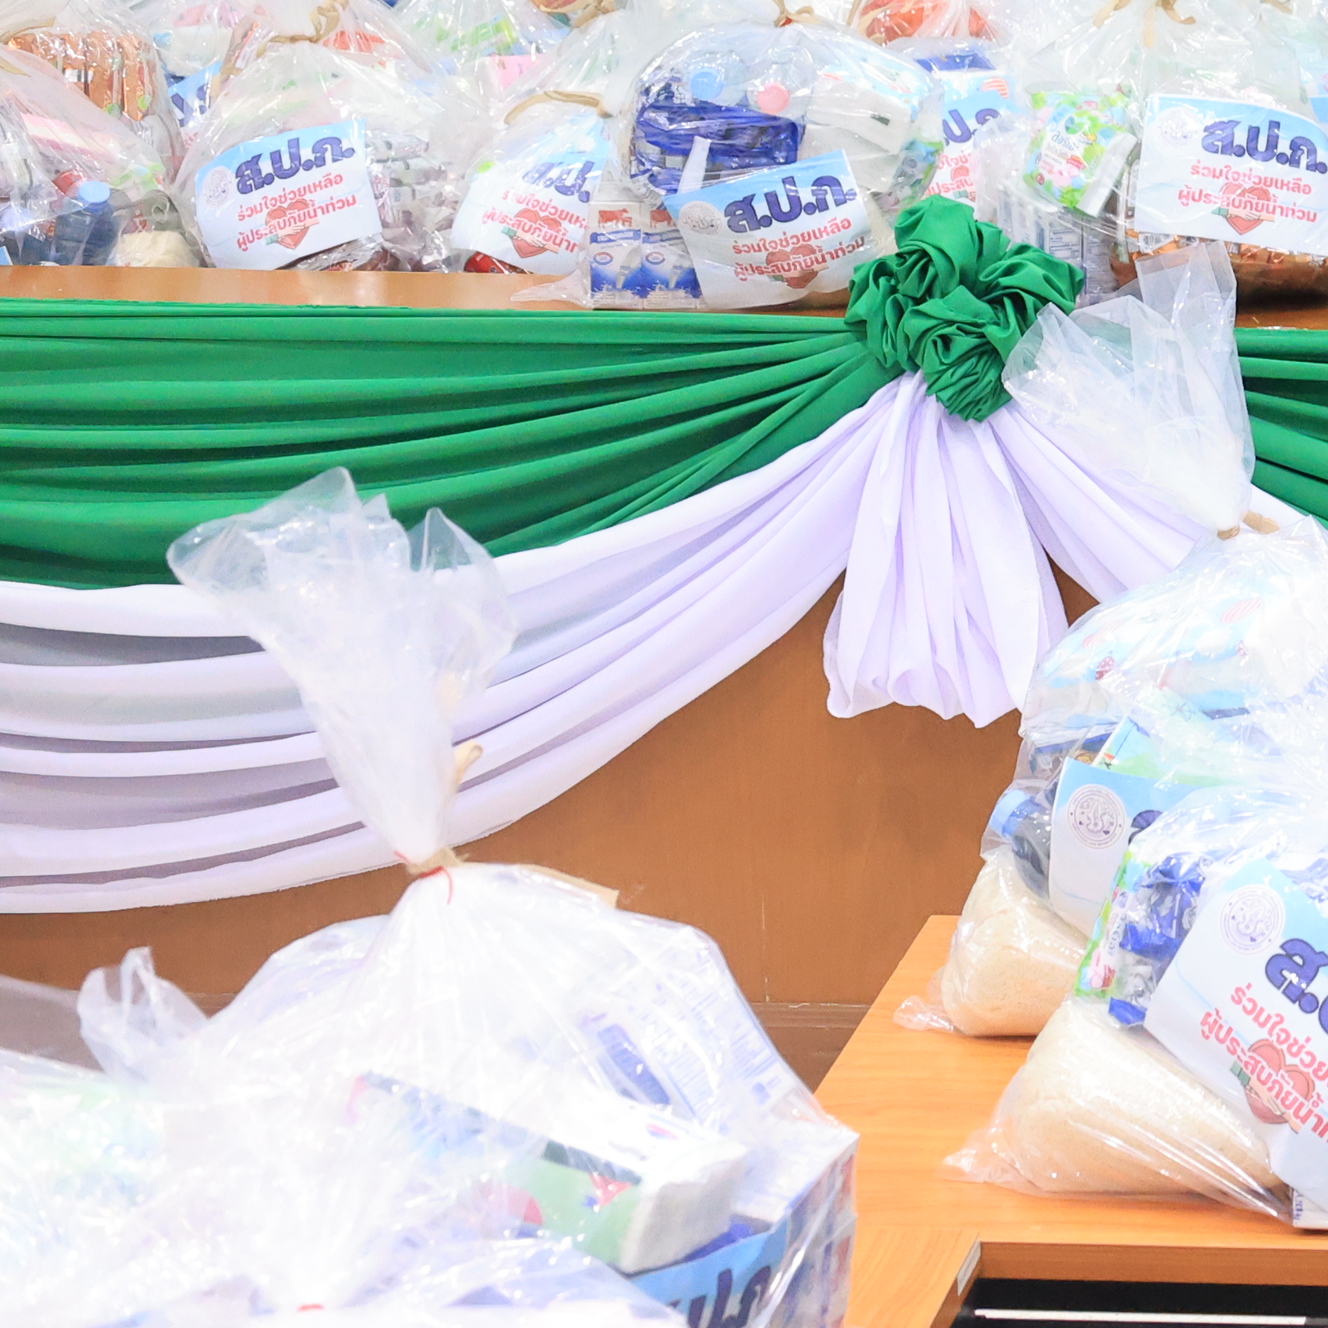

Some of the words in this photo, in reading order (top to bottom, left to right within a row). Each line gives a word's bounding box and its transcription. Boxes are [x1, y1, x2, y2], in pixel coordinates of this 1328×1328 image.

[234, 132, 356, 196] ส.ป.ก.
[1202, 116, 1327, 175] ส.ป.ก.
[724, 170, 857, 235] ส.ป.ก.
